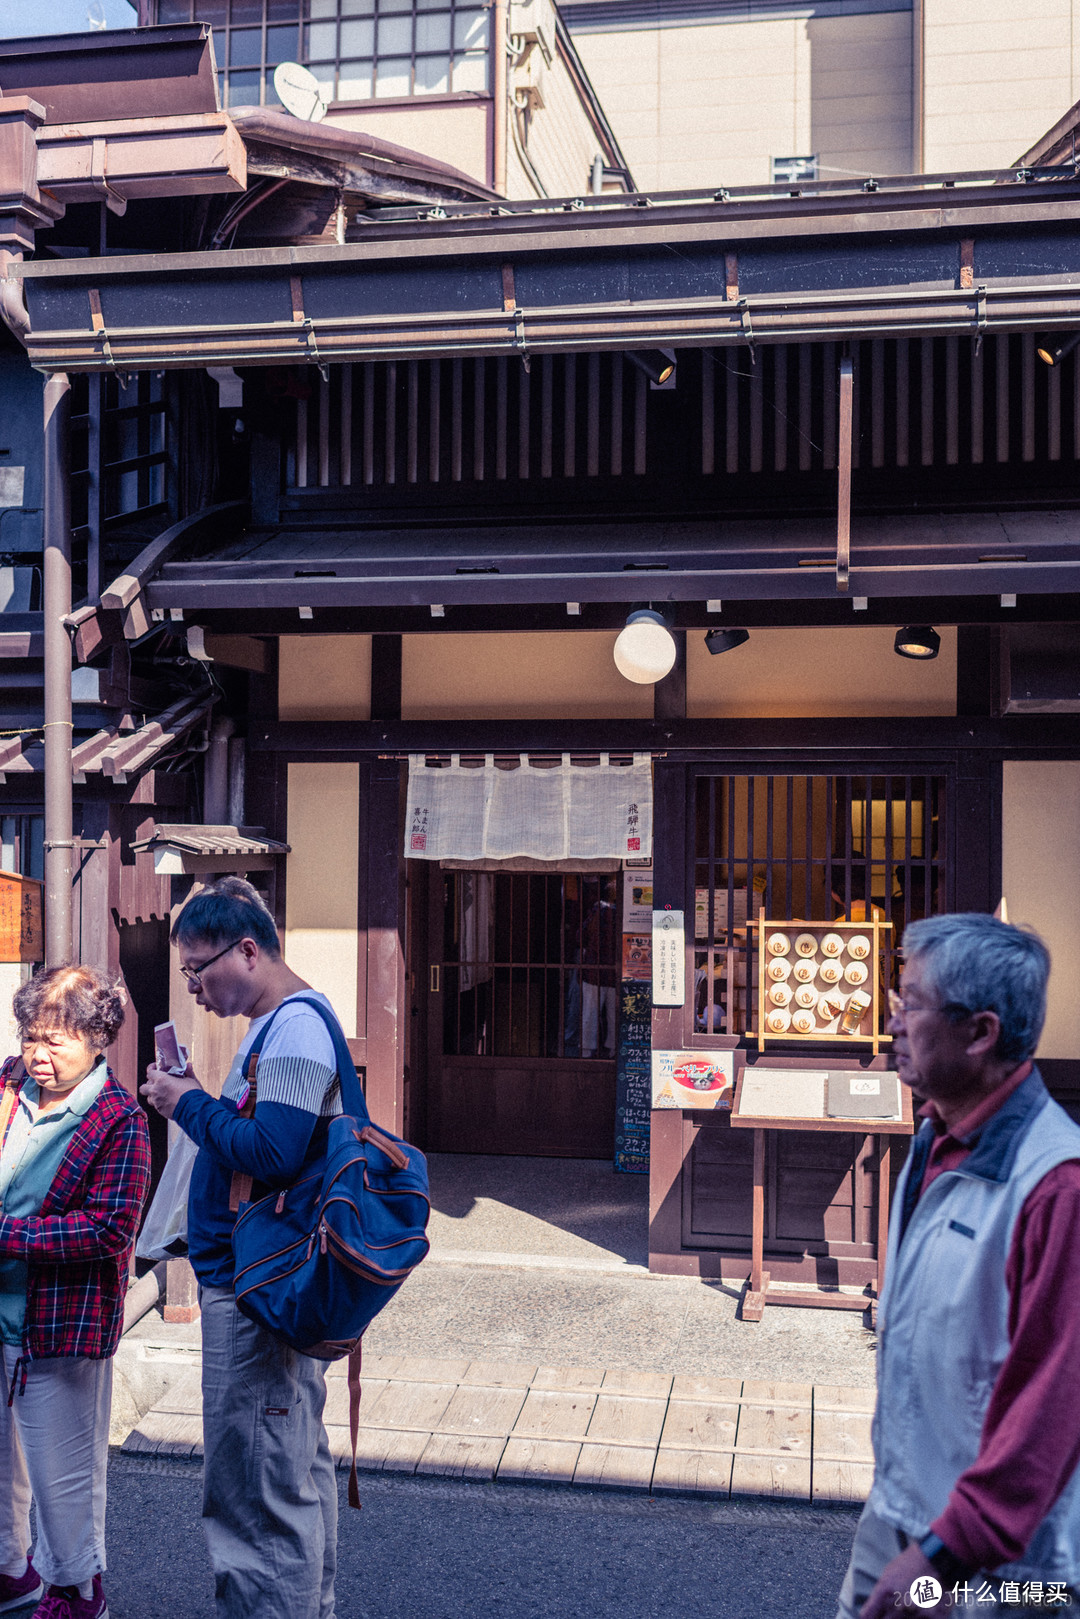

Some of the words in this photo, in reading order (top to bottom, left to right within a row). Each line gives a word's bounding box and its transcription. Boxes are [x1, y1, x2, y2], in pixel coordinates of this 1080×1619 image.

[411, 808, 421, 833] 喜八郎
[420, 808, 430, 833] 牛まん
[627, 803, 639, 836] 飛騨牛
